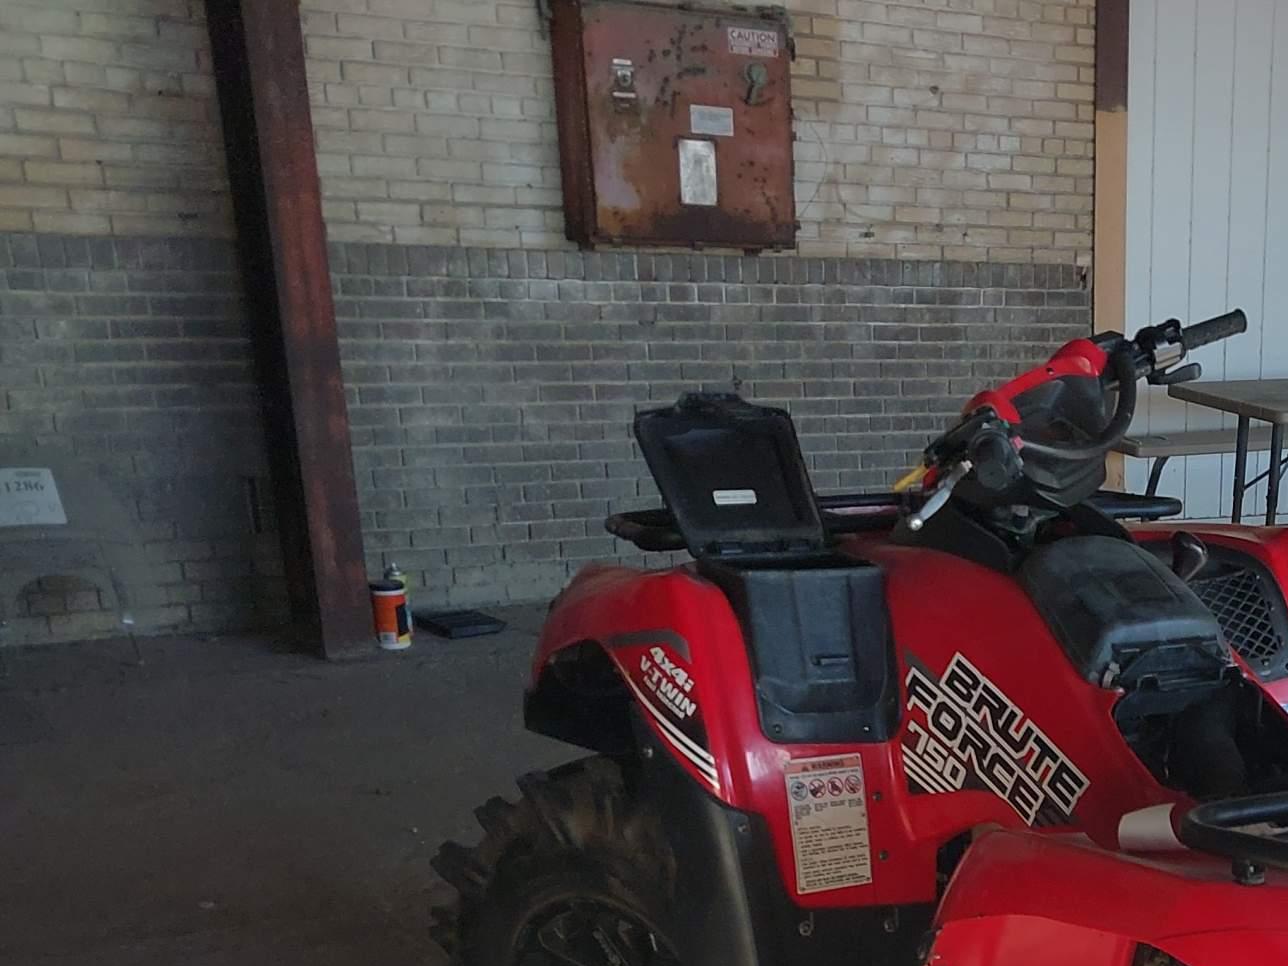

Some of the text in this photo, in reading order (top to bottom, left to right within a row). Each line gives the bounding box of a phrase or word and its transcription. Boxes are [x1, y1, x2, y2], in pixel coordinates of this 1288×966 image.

[730, 30, 775, 42] CAUTION
[905, 666, 1045, 826] FORCE
[907, 720, 967, 790] 750
[939, 651, 1091, 816] BRUTE
